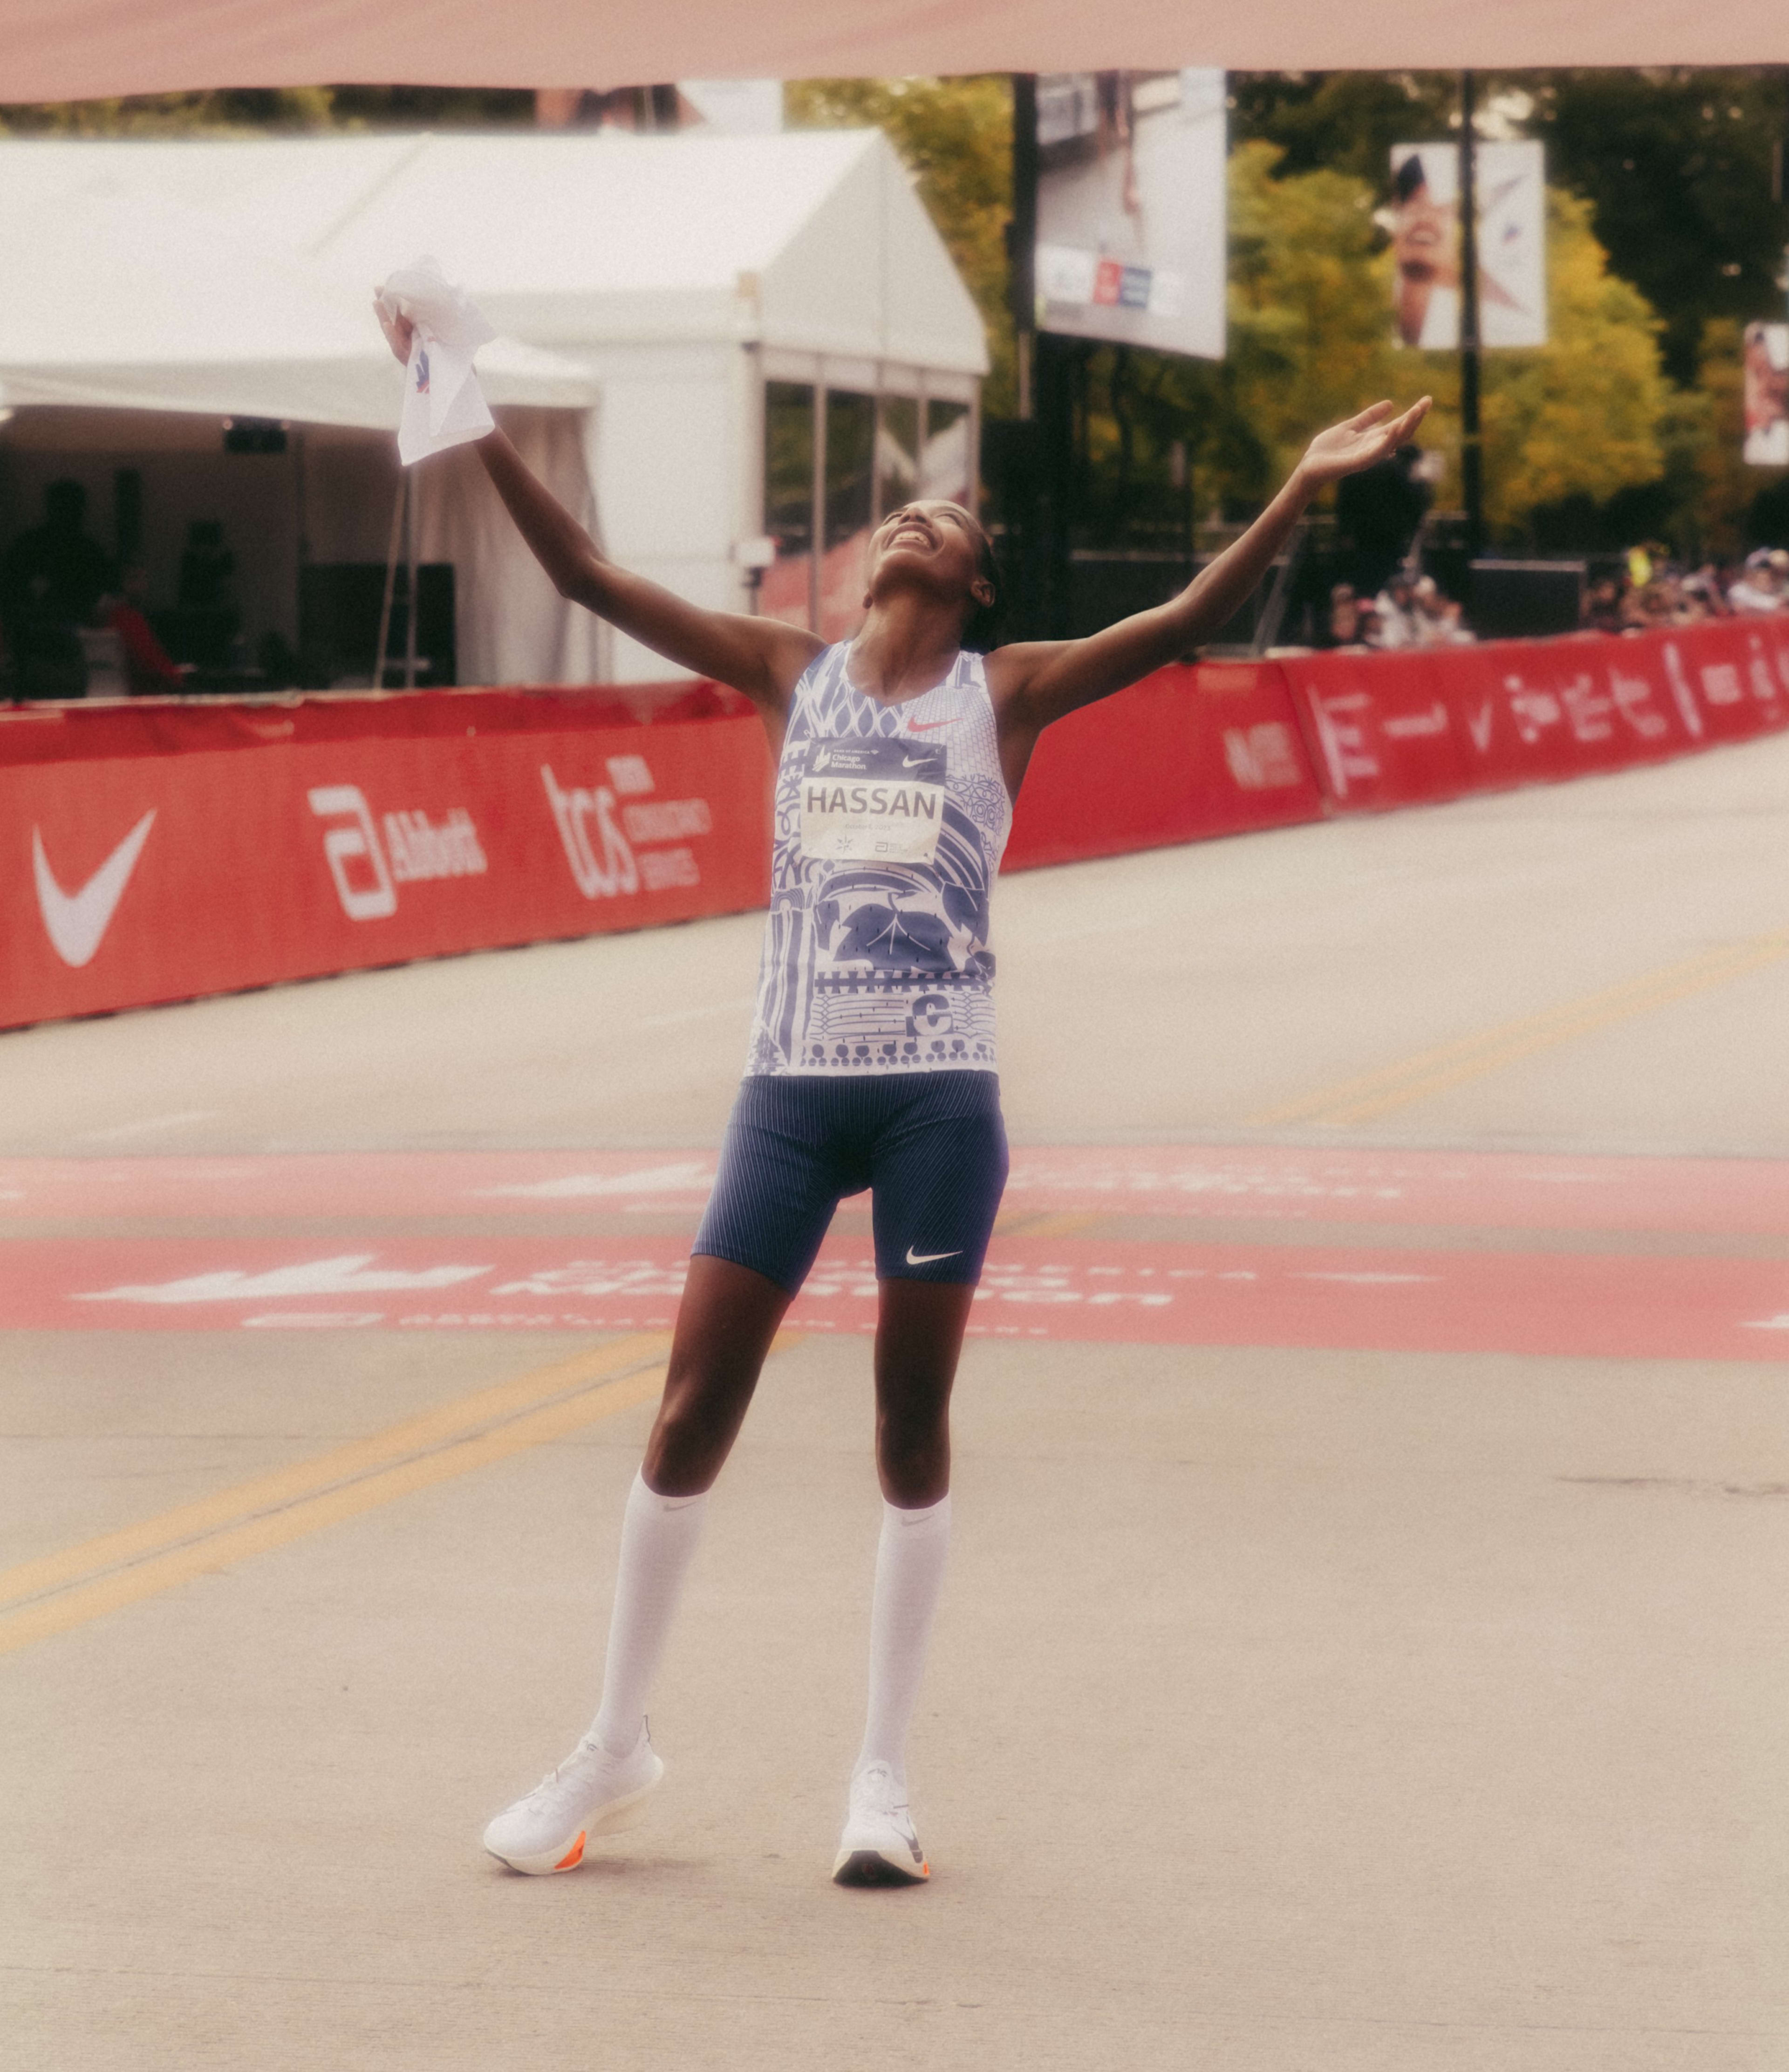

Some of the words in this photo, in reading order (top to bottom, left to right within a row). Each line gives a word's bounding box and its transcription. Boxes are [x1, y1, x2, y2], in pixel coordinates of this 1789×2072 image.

[832, 754, 860, 763] Chicago
[831, 761, 866, 770] Marathon
[807, 786, 936, 820] HASSAN
